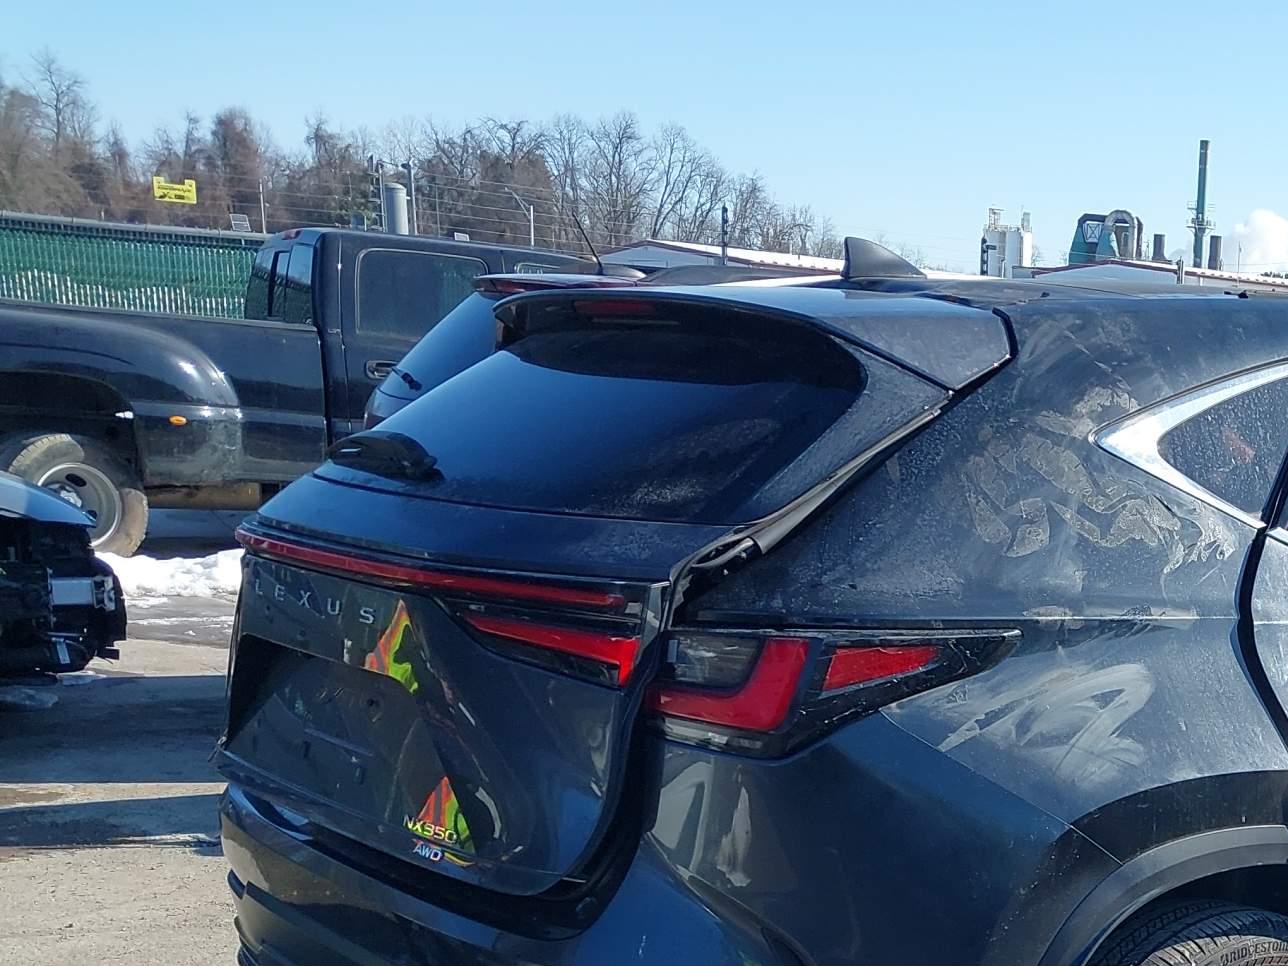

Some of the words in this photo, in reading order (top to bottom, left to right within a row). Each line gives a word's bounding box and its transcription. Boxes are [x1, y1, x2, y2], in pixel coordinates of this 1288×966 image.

[255, 579, 375, 624] LEXUS
[402, 814, 458, 843] NX350
[412, 843, 442, 861] AWD
